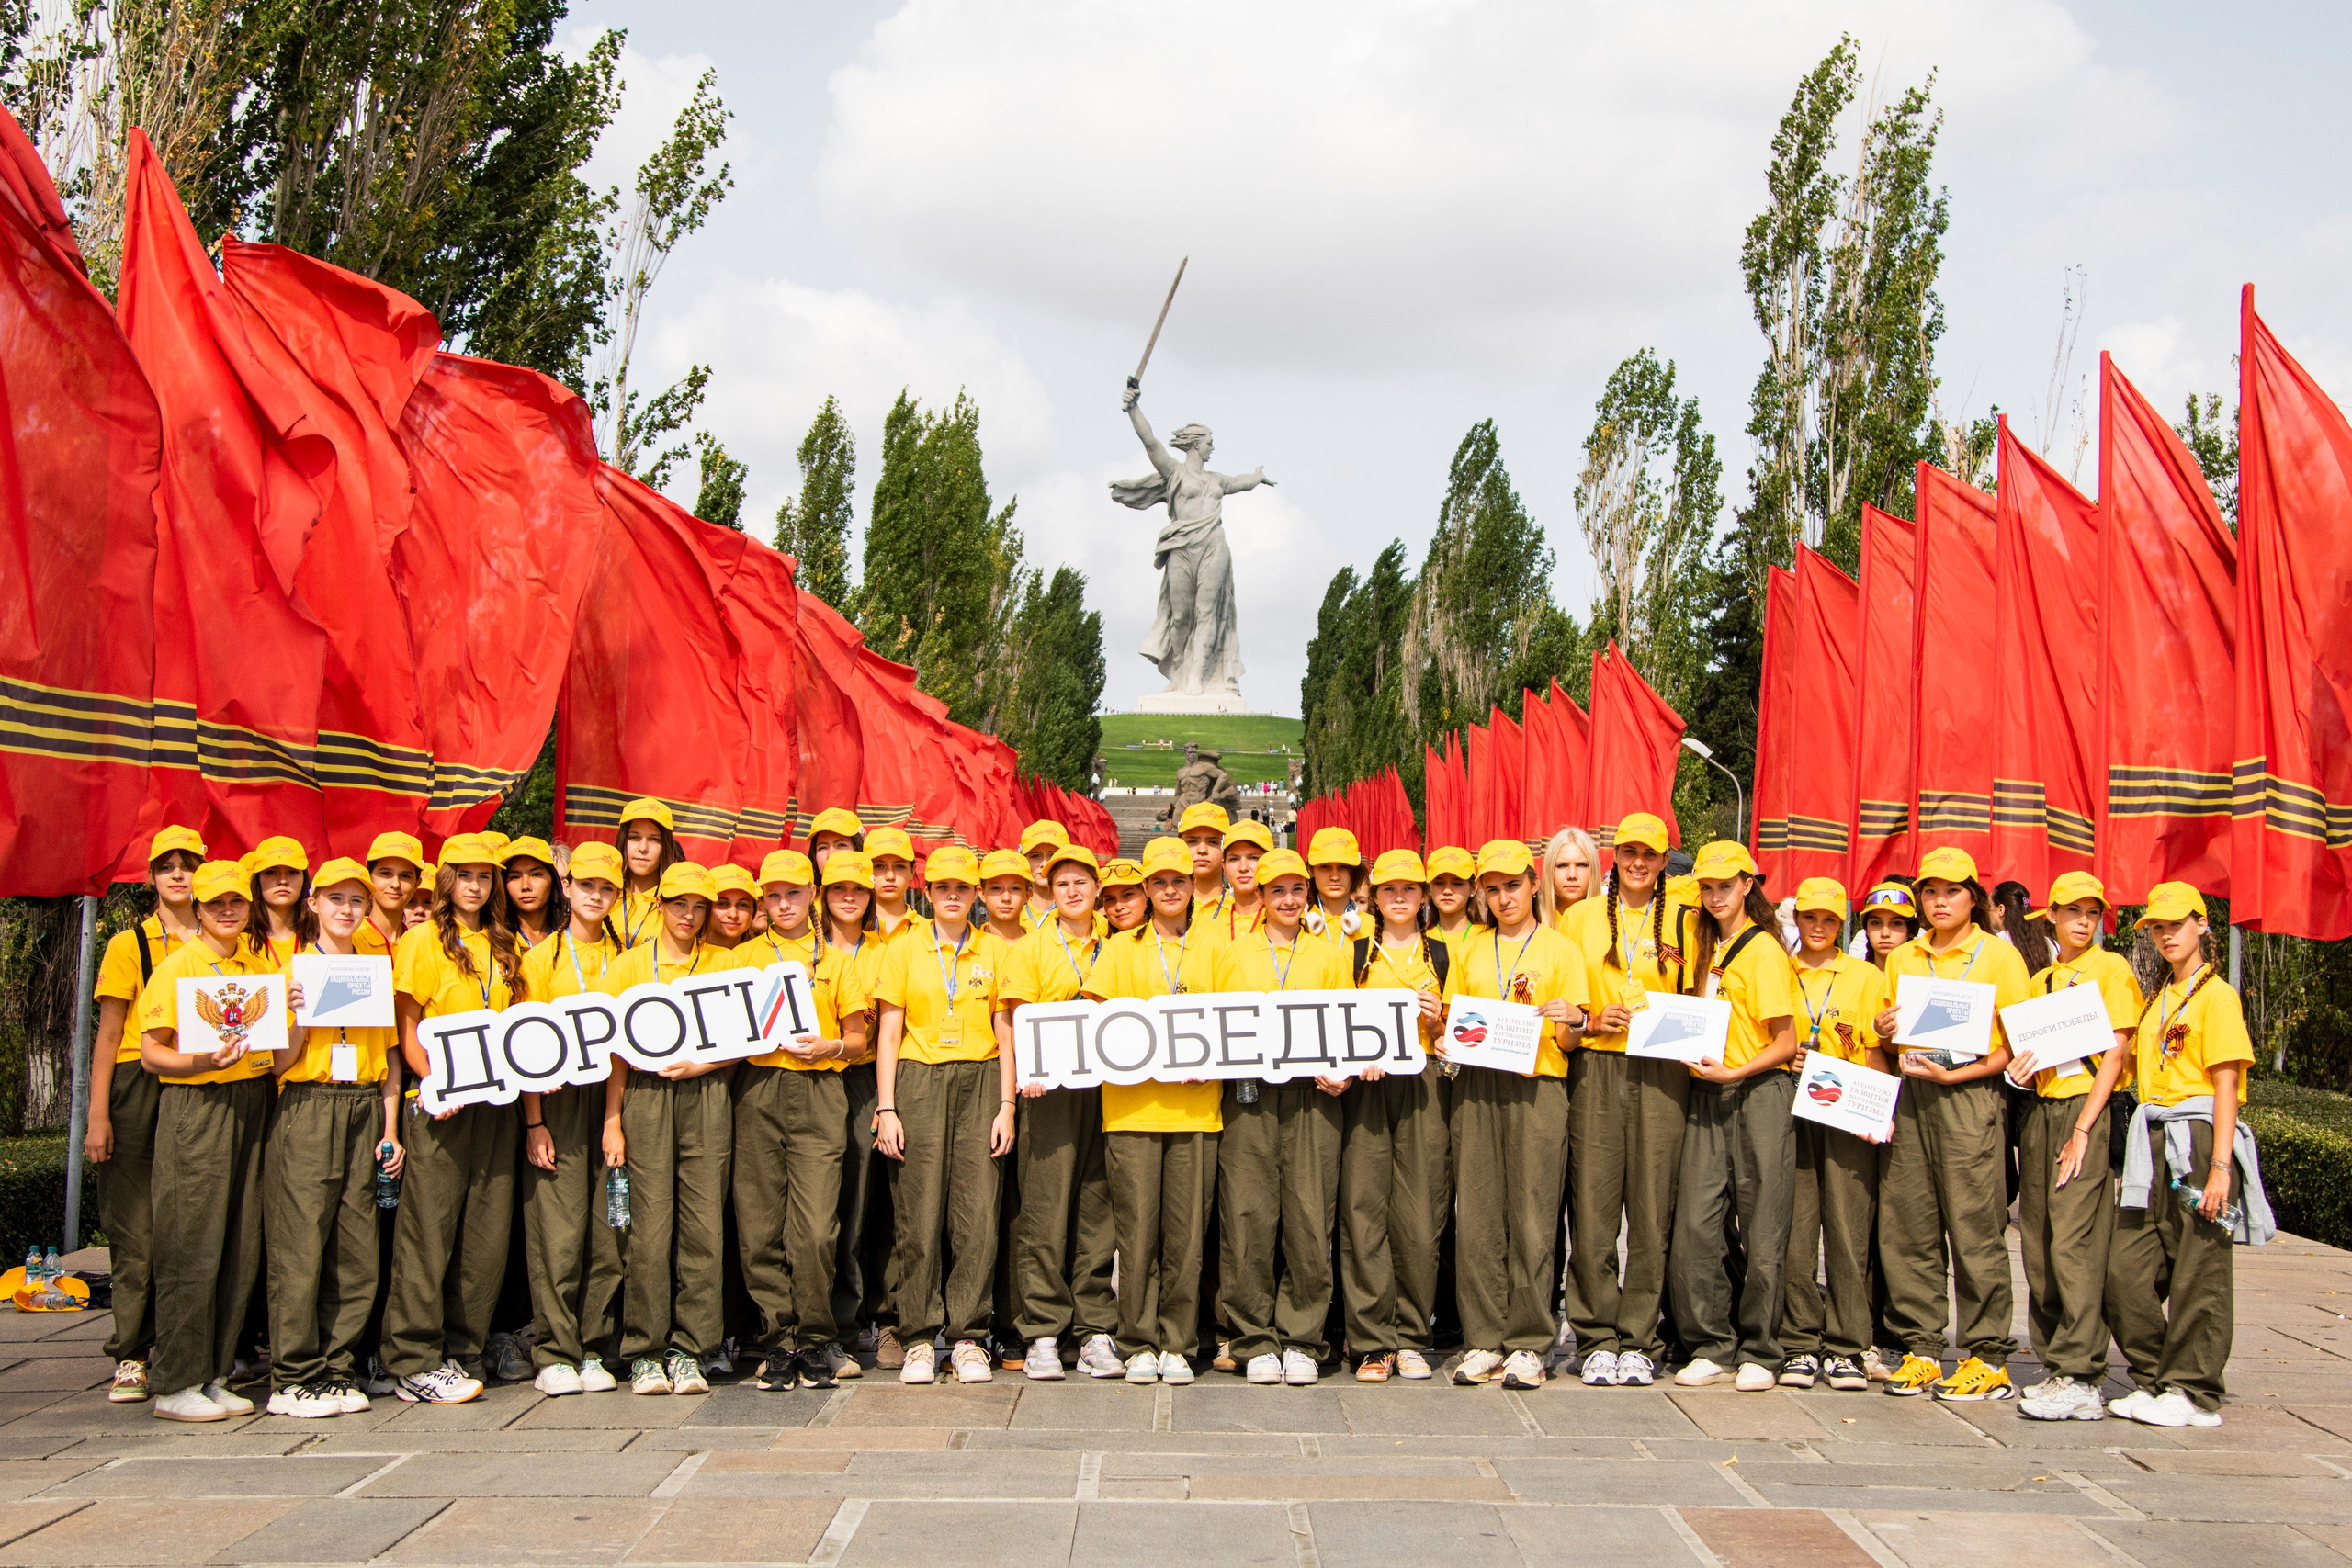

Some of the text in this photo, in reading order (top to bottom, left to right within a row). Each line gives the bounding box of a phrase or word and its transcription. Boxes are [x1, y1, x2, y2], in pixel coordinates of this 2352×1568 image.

[1930, 998, 1970, 1010] НАЦИОНАЛЬНЫЕ
[1946, 1007, 1970, 1016] ПРОЕКТЫ
[1950, 1013, 1969, 1021] РОССИИ
[1497, 1017, 1535, 1027] АГЕНТСТВО
[2018, 1011, 2098, 1043] ДОРОГИ ПОБЕДЫ
[1495, 1023, 1534, 1034] РАЗВИТИЯ
[433, 974, 809, 1102] ДОРОГИ
[1025, 1001, 1413, 1079] ПОБЕДЫ
[1493, 1032, 1532, 1041] ВНУТРЕННЕГО
[1492, 1037, 1531, 1049] ТУРИЗМА
[1852, 1080, 1892, 1097] АГЕНТСТВО
[1850, 1086, 1889, 1104] РАЗВИТИЯ
[1847, 1100, 1885, 1117] ТУРИЗМА
